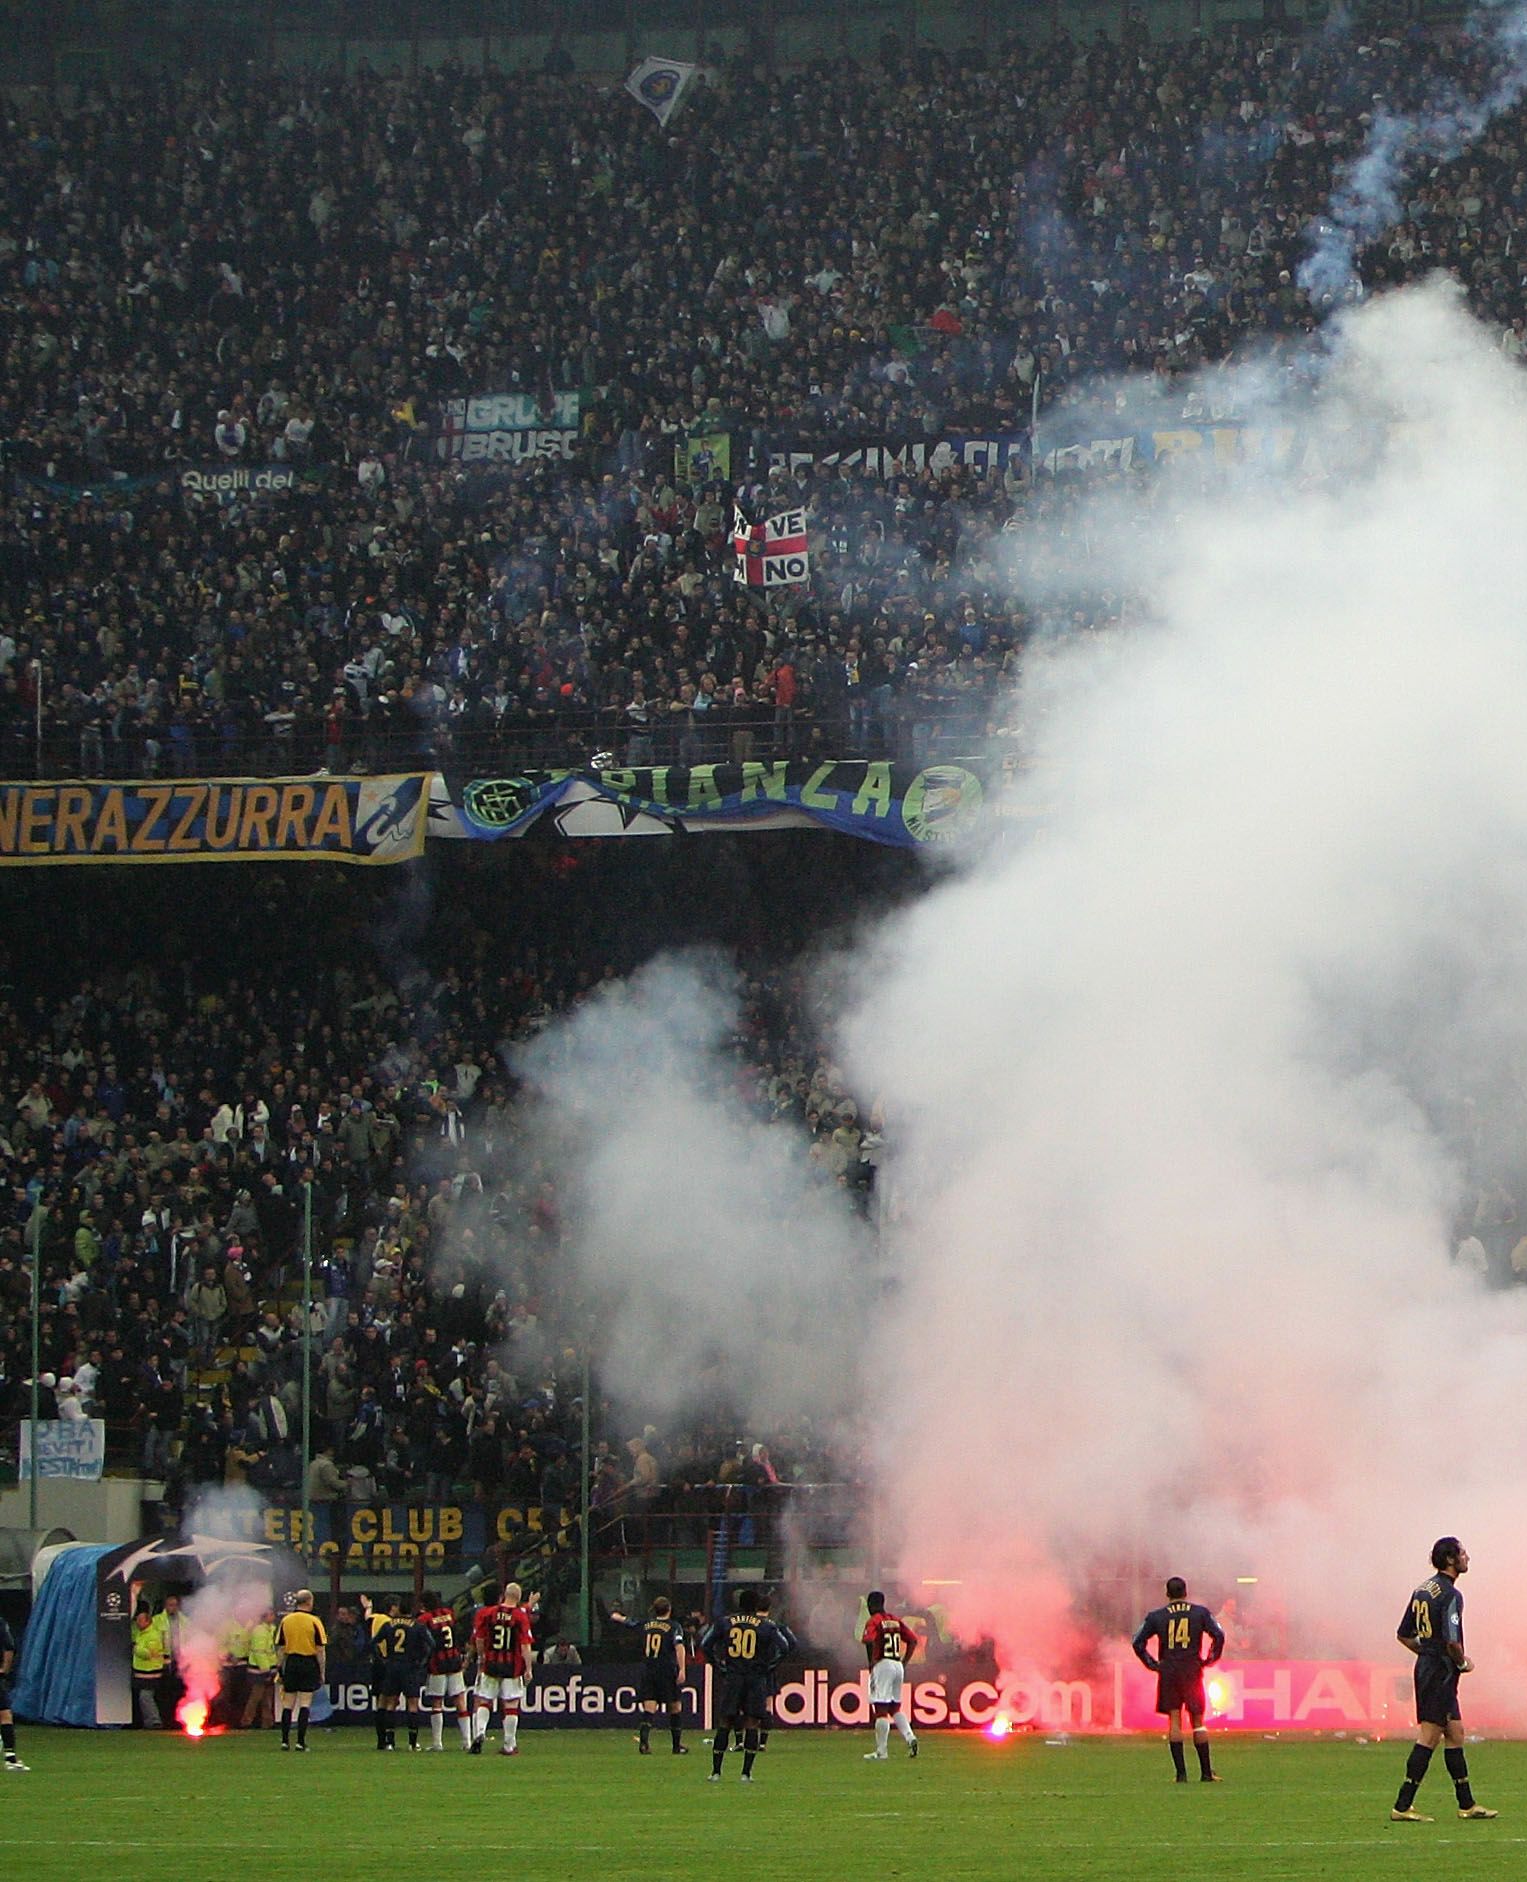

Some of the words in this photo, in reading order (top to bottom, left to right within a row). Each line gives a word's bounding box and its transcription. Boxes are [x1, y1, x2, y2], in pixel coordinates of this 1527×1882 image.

[255, 470, 294, 489] del
[765, 558, 805, 581] NO
[352, 1507, 464, 1541] CLUB
[394, 1628, 406, 1653] 2
[441, 1626, 453, 1648] 3
[493, 1625, 511, 1649] 31
[728, 1627, 757, 1659] 30
[883, 1632, 901, 1658] 20
[1168, 1617, 1191, 1649] 14
[645, 1633, 662, 1659] 19
